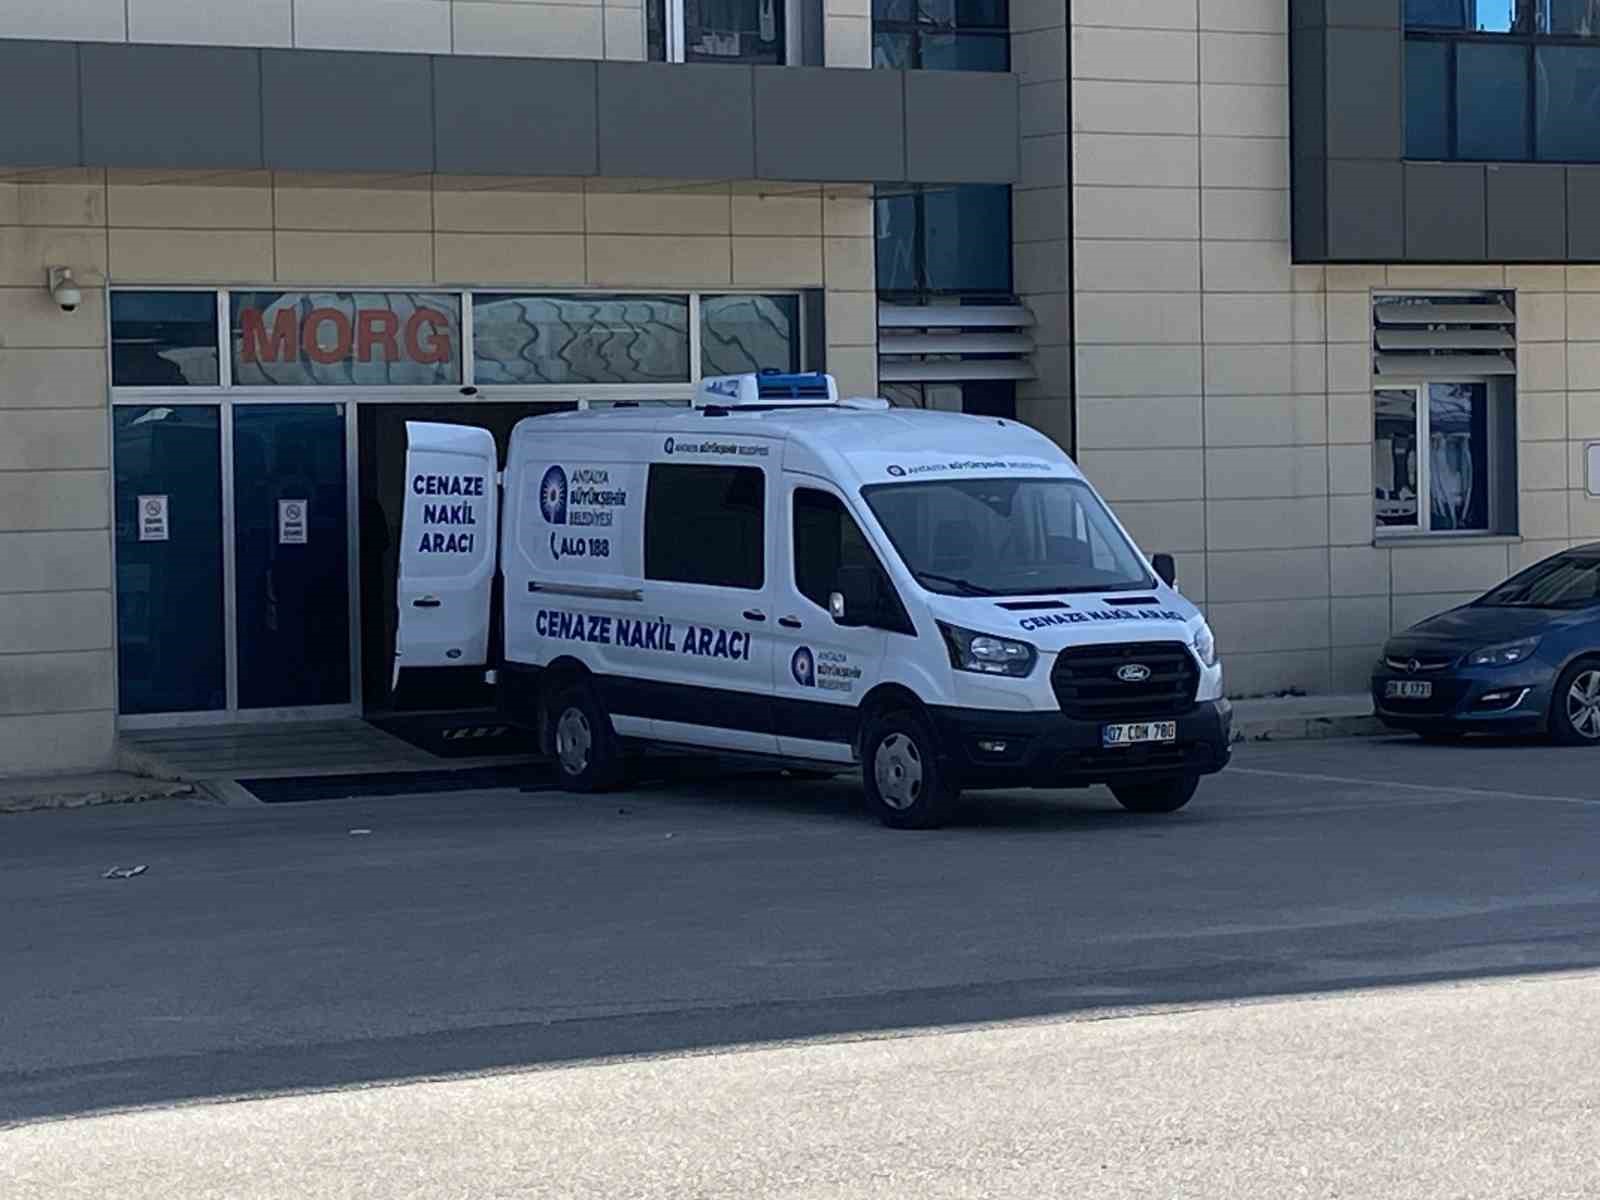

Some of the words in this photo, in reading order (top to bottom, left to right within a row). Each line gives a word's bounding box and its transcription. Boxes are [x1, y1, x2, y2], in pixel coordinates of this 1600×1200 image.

[240, 306, 451, 364] MORG
[413, 475, 484, 496] CENAZE
[571, 470, 609, 484] ANTALYA
[423, 500, 476, 525] NAKİL
[419, 533, 474, 553] ARACI
[560, 537, 586, 556] ALO
[588, 538, 610, 558] 188
[1019, 612, 1088, 631] CENAZE
[535, 609, 612, 645] CENAZE
[615, 616, 676, 652] NAKİL
[682, 626, 751, 661] ARACI
[1109, 726, 1123, 741] 07
